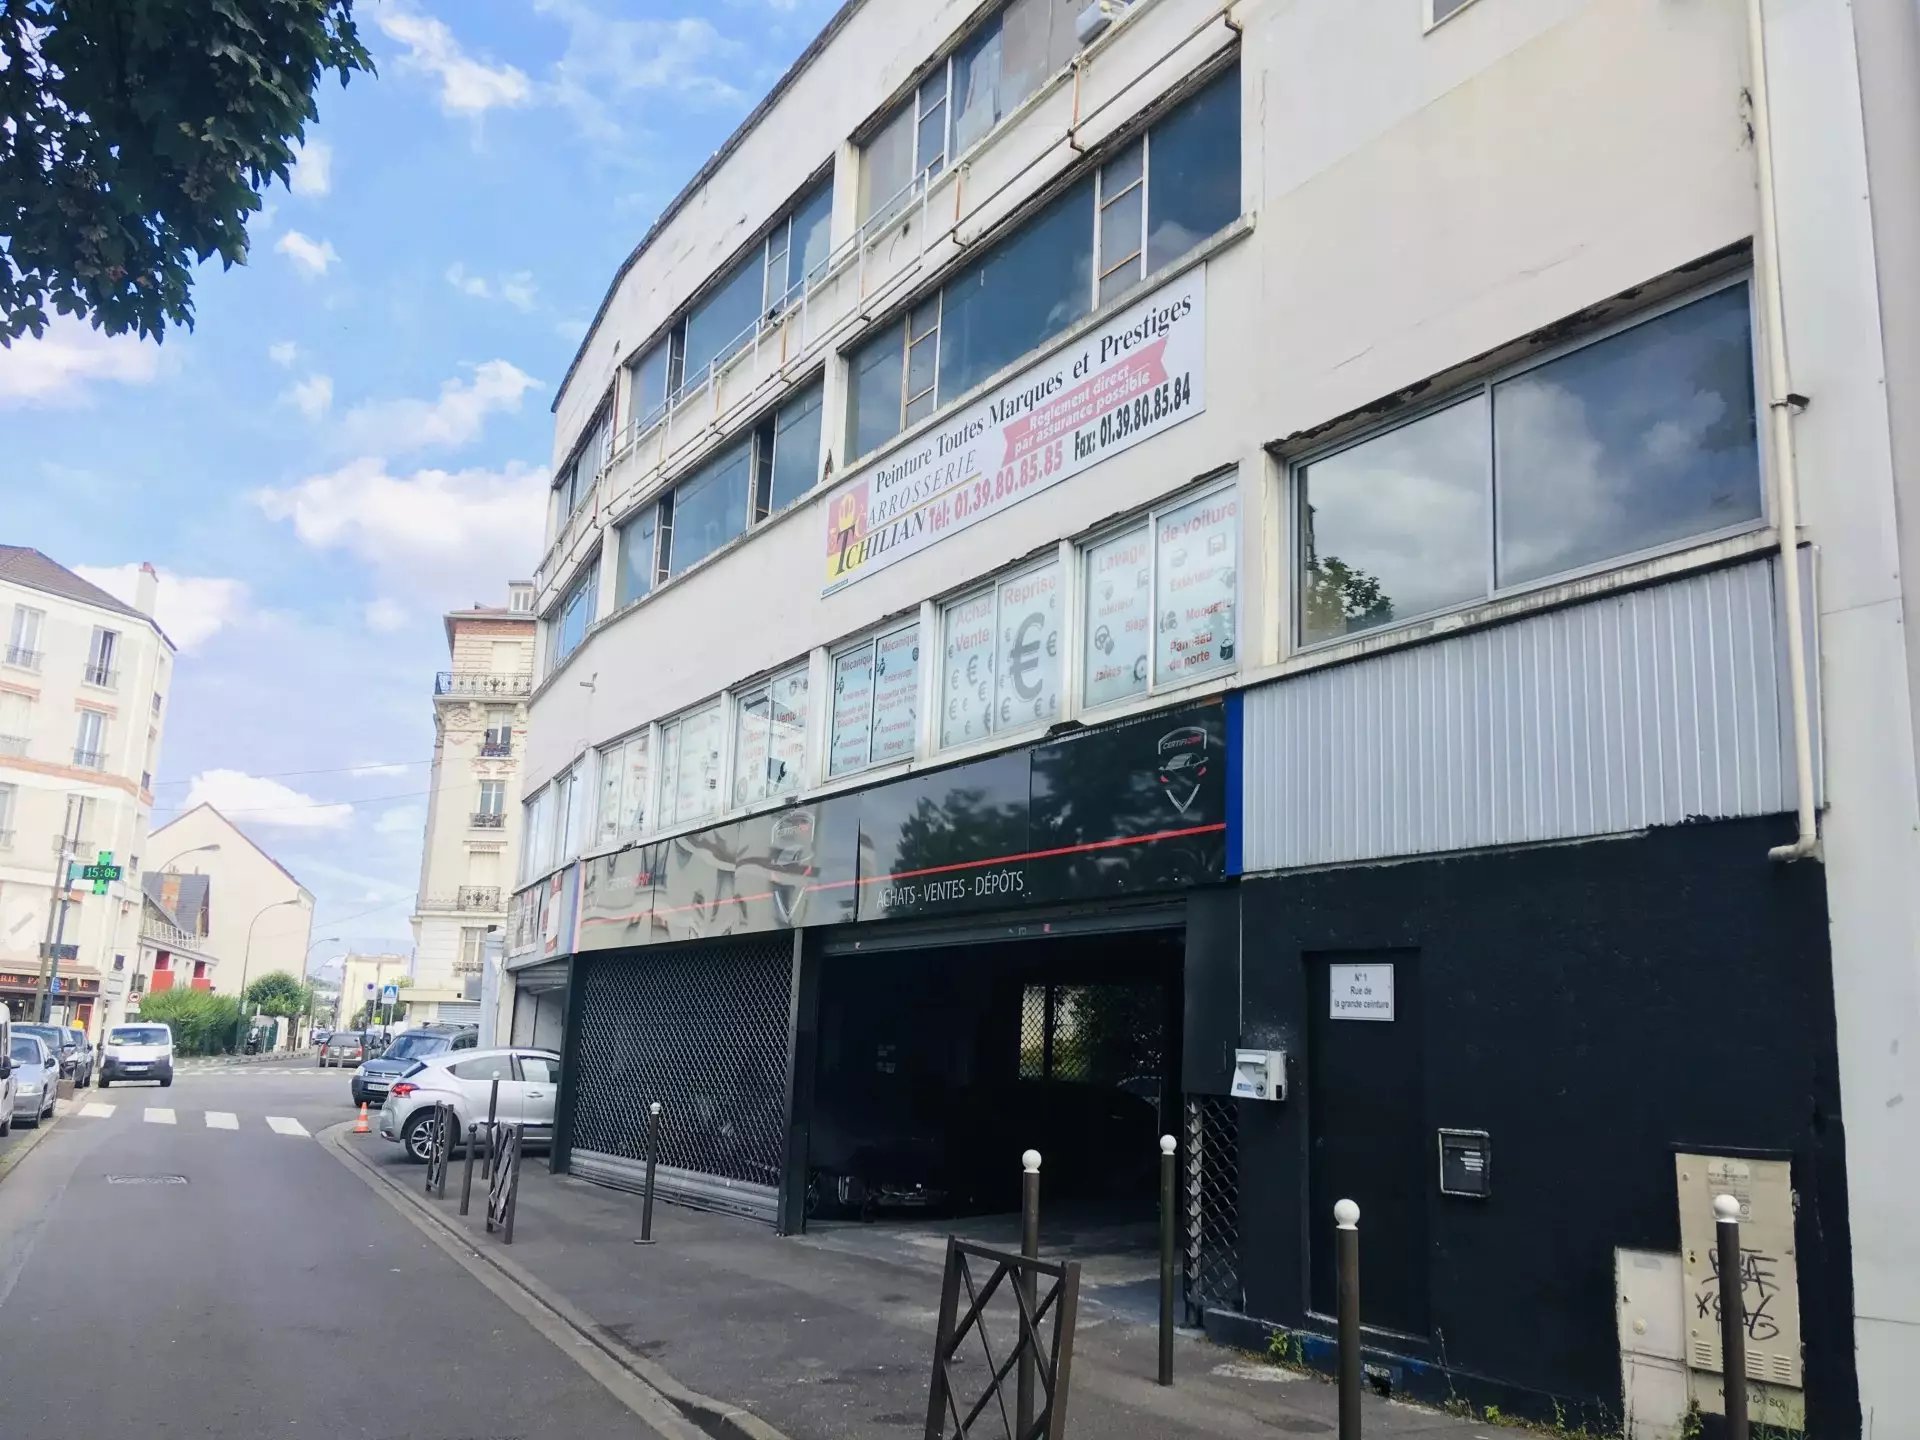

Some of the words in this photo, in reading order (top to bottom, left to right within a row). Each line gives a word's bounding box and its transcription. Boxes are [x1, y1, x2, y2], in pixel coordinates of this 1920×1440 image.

[875, 448, 932, 493] Peinture
[936, 417, 984, 458] Toutes
[988, 371, 1063, 431] Marques
[1072, 352, 1090, 379] et
[1099, 294, 1191, 364] Prestiges
[1093, 364, 1130, 397] direct
[1014, 434, 1034, 458] par
[1036, 403, 1093, 444] assurance
[1097, 370, 1151, 415] possible
[834, 508, 928, 576] TCHILIAN
[954, 439, 1064, 521] 01.39.80.85.85
[1074, 430, 1096, 462] Fax:
[1100, 371, 1191, 448] 01.39.80.85.84
[1160, 524, 1179, 544] de
[1183, 500, 1238, 536] voiture
[1003, 575, 1056, 608] Reprise
[956, 627, 990, 651] Vente
[86, 867, 117, 878] 15:06
[876, 885, 917, 909] ACHATS
[924, 879, 966, 902] VENTES
[975, 869, 1025, 897] DÉPÔTS
[1334, 998, 1340, 1008] la
[1340, 999, 1362, 1010] grande
[1363, 999, 1390, 1009] ceinture
[1350, 985, 1363, 995] Rue
[1364, 986, 1372, 995] de
